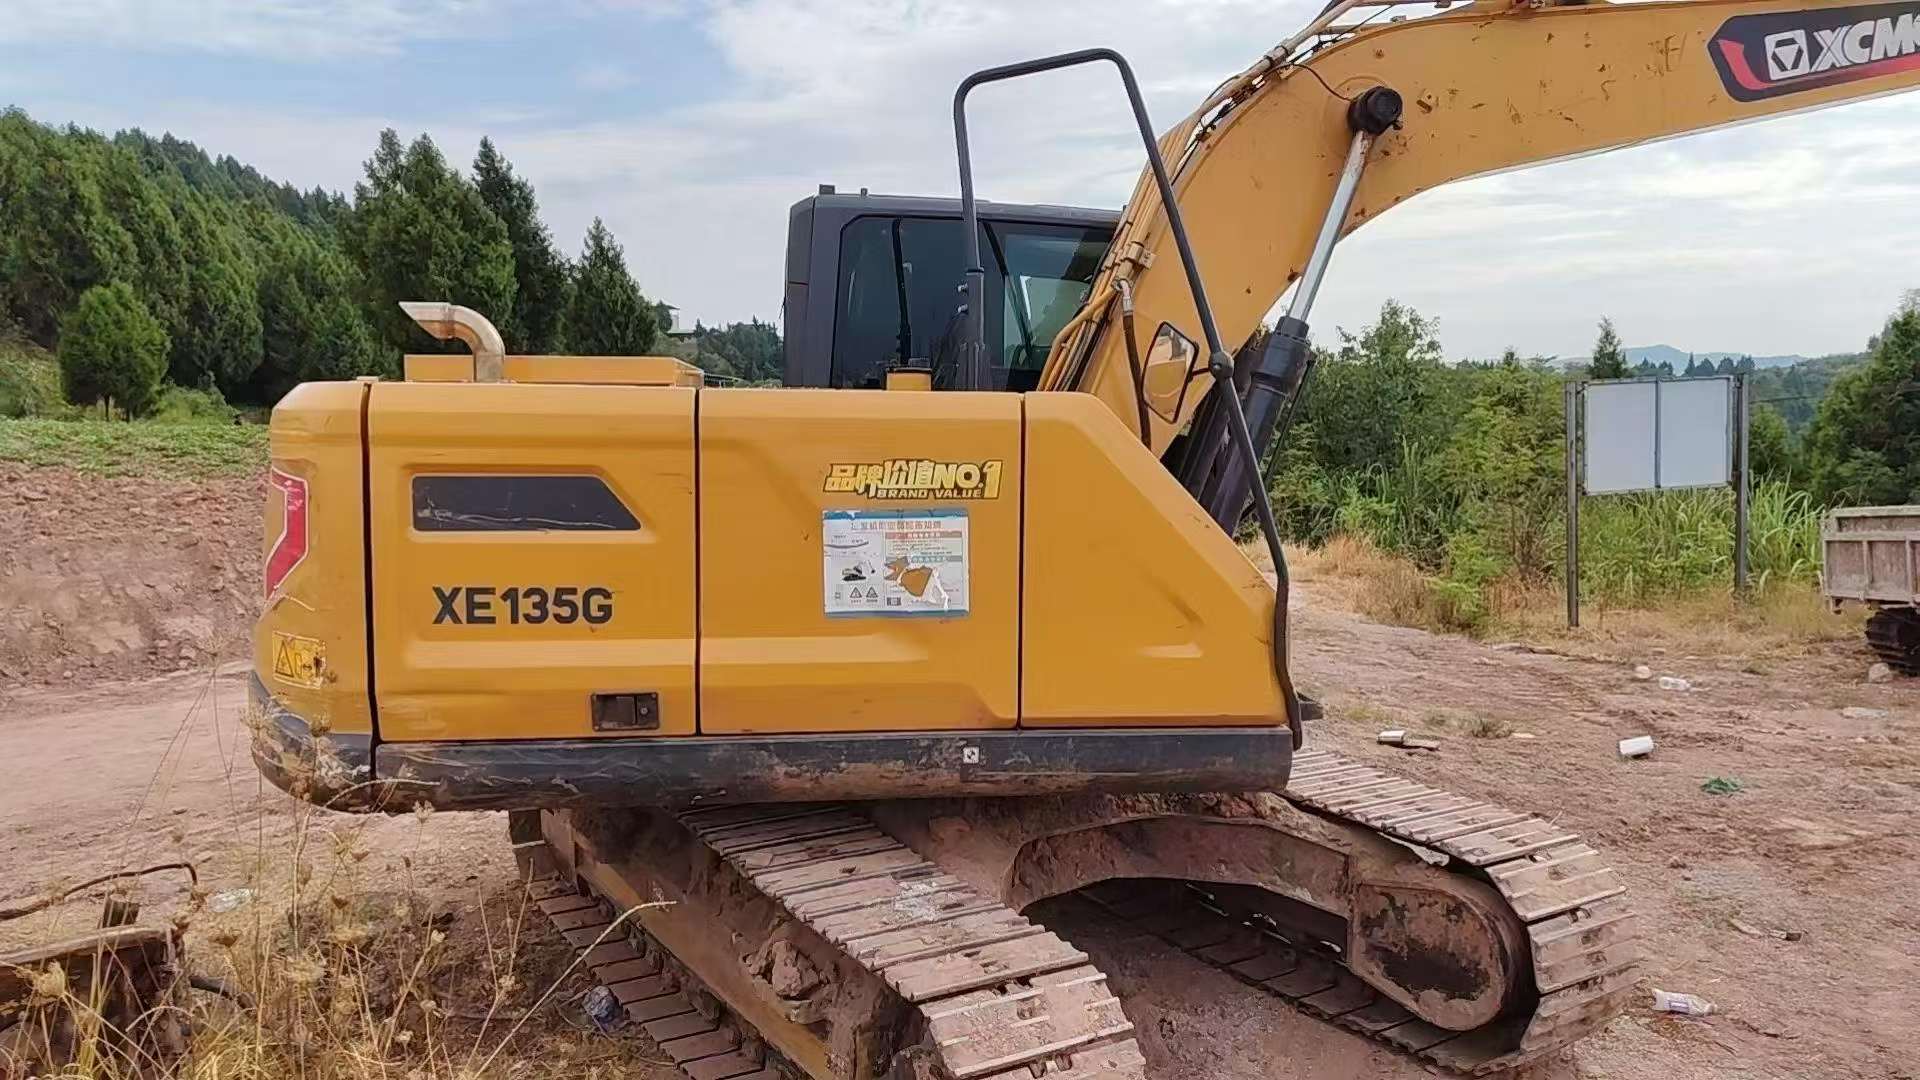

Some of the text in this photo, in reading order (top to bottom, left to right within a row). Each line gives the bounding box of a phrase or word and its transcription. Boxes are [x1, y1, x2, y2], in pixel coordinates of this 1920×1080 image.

[877, 489, 982, 498] BRAND VALUE
[432, 586, 613, 625] XE135G
